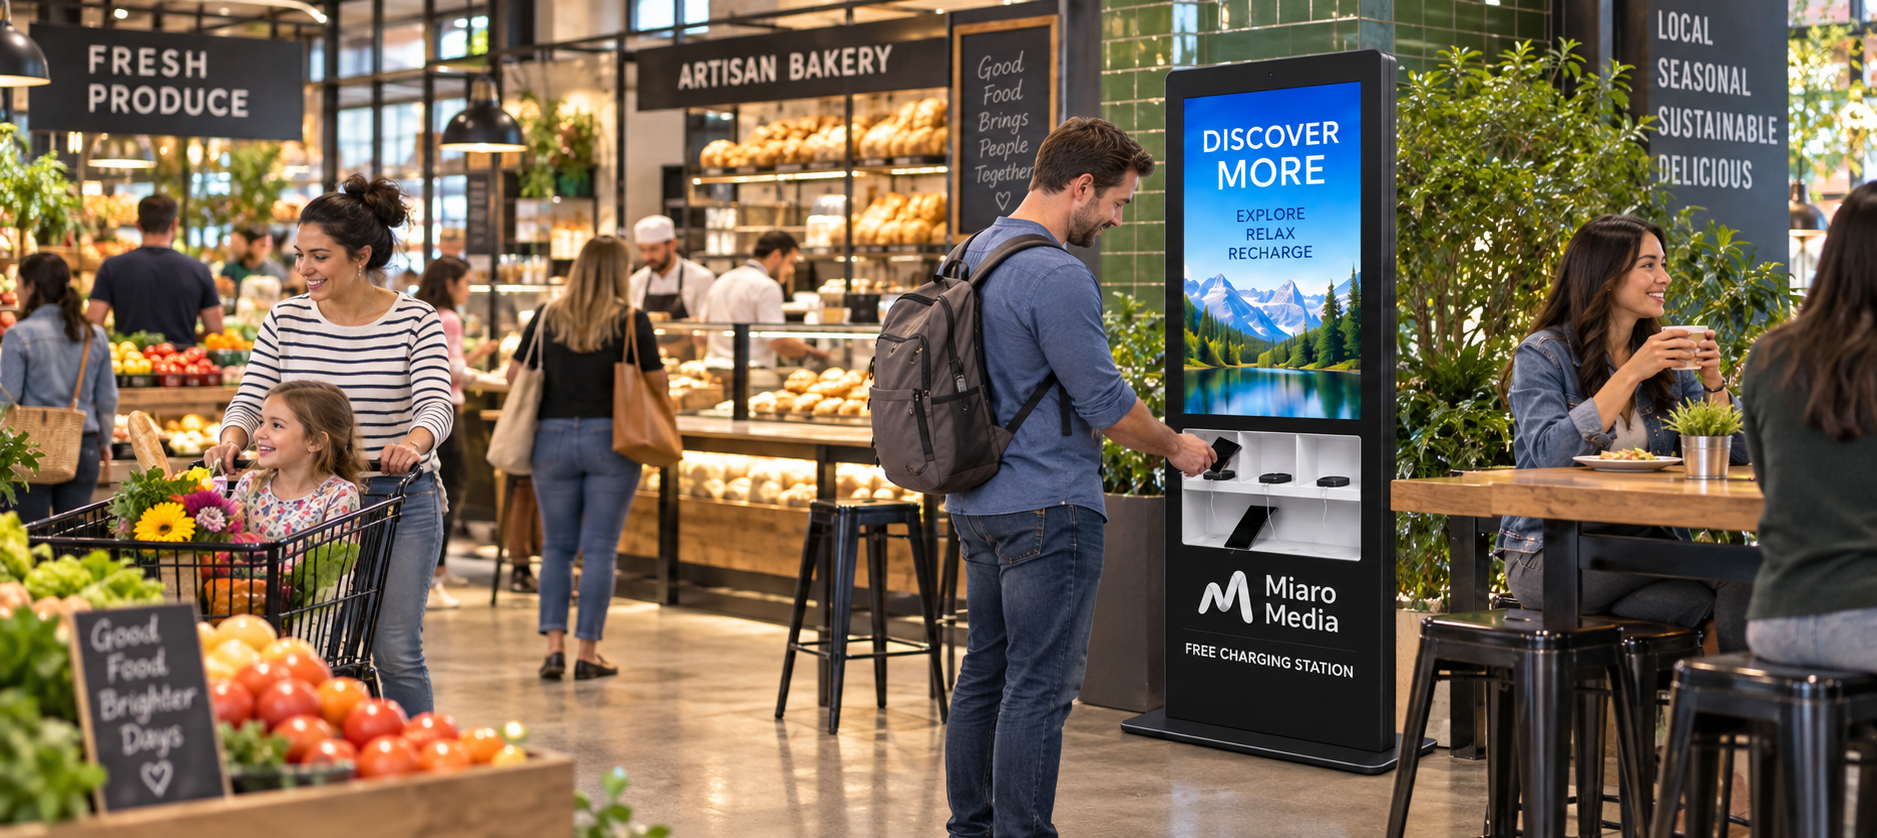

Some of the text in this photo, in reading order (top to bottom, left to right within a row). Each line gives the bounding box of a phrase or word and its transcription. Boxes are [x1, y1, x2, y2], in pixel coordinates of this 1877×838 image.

[1658, 9, 1713, 45] LOCAL
[88, 44, 207, 79] FRESH
[677, 44, 893, 90] ARTISAN BAKERY
[977, 50, 1025, 81] Good
[1657, 57, 1751, 96] SEASONAL
[88, 83, 249, 118] PRODUCE
[983, 78, 1024, 106] Food
[978, 111, 1029, 135] Brings
[1203, 121, 1340, 153] DISCOVER
[1657, 105, 1778, 145] SUSTAINABLE
[979, 135, 1029, 162] People
[1218, 154, 1325, 190] MORE
[1658, 154, 1753, 190] DELICIOUS
[1236, 207, 1306, 223] EXPLORE
[1246, 227, 1296, 241] RELAX
[1228, 245, 1313, 260] RECHARGE
[1265, 574, 1337, 604] Miaro
[90, 612, 162, 653] Good
[1265, 602, 1339, 633] Media
[106, 645, 170, 684] Food
[1185, 642, 1354, 679] FREE CHARGING STATION
[97, 683, 198, 726] Brighter
[118, 722, 185, 759] Days
